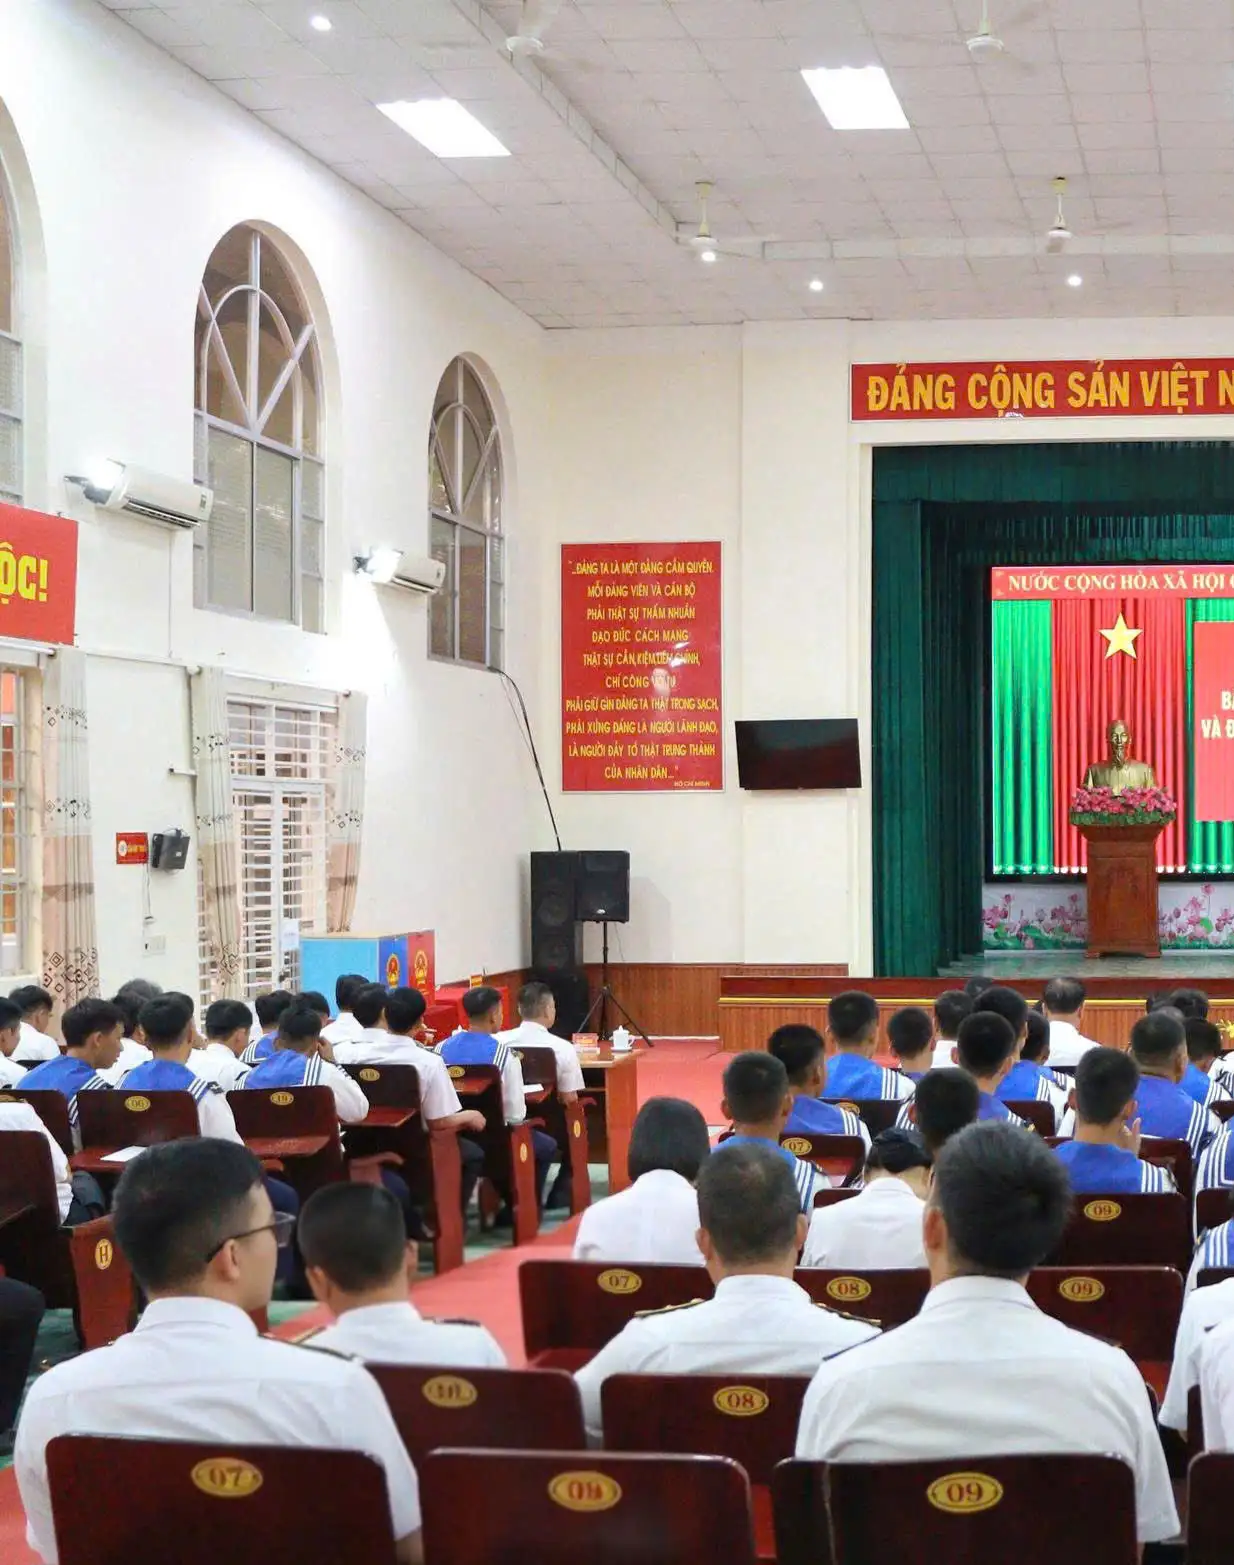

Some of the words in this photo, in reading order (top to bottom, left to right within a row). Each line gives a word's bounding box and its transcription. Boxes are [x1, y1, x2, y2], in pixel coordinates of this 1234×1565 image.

[867, 363, 956, 411] ĐẢNG
[967, 363, 1055, 418] CỘNG
[1067, 359, 1130, 408] SẢN
[1140, 361, 1209, 414] VIỆT
[600, 562, 609, 575] TA
[611, 560, 620, 575] LÀ
[650, 582, 662, 597] VÀ
[664, 581, 682, 597] CÁN
[1008, 571, 1060, 591] NƯỚC
[1063, 573, 1116, 593] CỘNG
[1162, 570, 1188, 589] XÃ
[1191, 572, 1225, 593] HỘI
[635, 626, 660, 642] CÁCH
[671, 697, 696, 711] TRONG
[1201, 714, 1222, 738] VÀ
[662, 743, 687, 757] TRUNG
[689, 740, 716, 756] THÀNH
[609, 1274, 629, 1289] 07
[837, 1282, 859, 1296] 08
[1071, 1283, 1092, 1296] 09
[727, 1392, 755, 1409] 08
[208, 1465, 244, 1487] 07
[946, 1482, 984, 1503] 09
